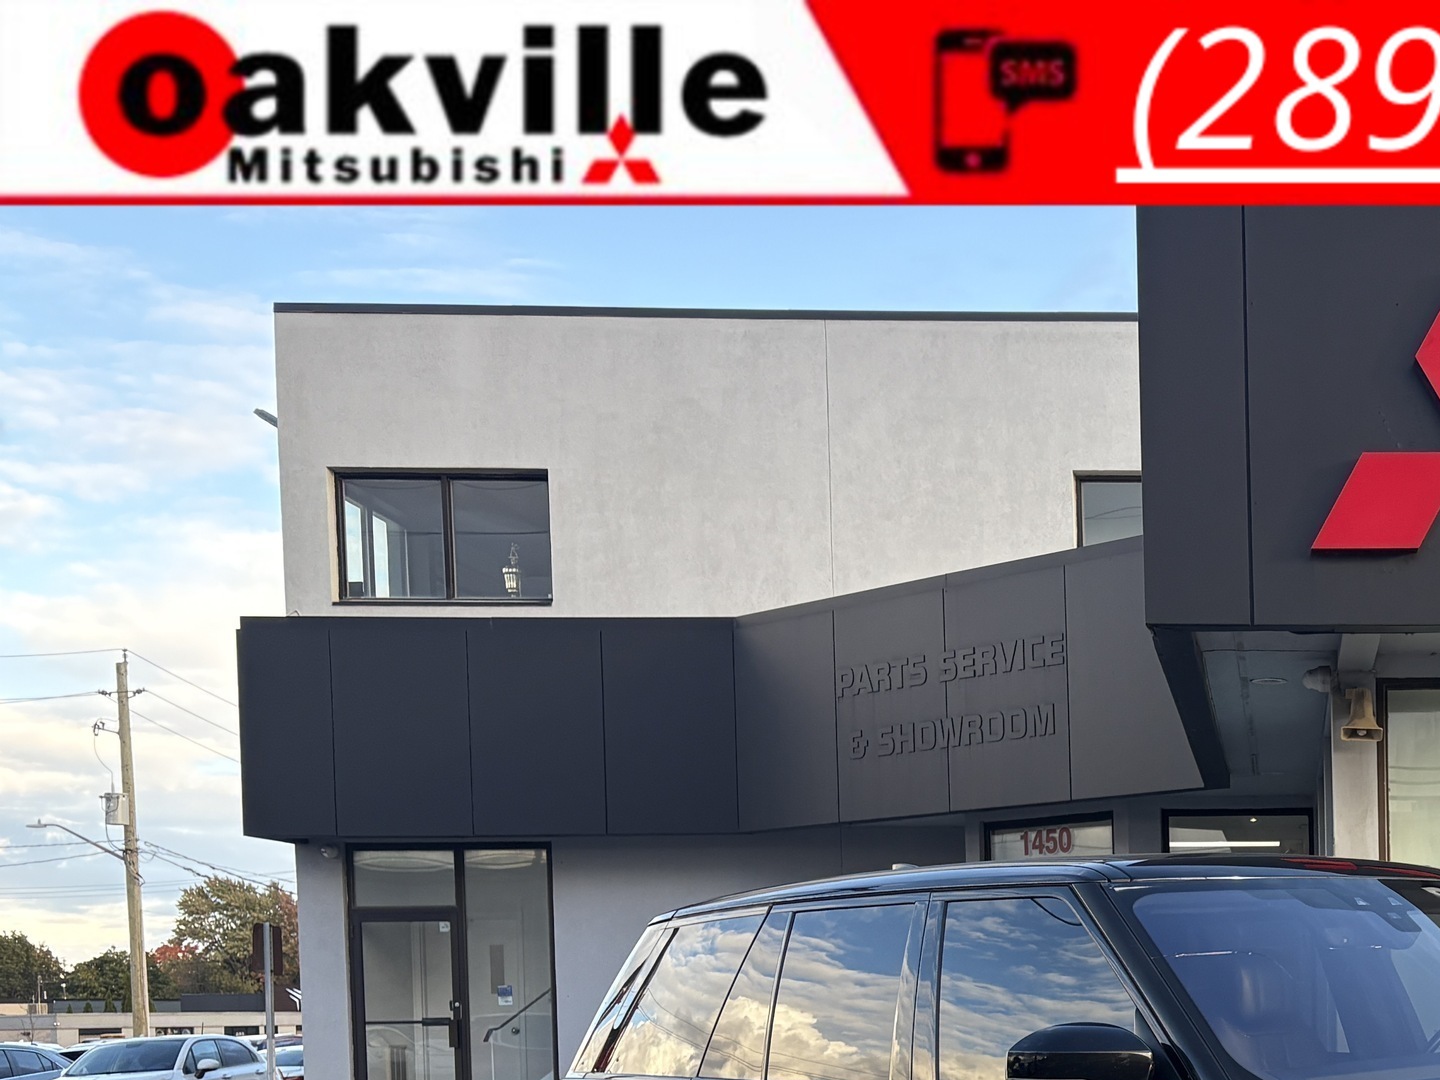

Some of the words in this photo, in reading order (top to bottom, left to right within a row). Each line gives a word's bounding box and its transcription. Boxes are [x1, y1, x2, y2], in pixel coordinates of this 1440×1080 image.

[836, 655, 928, 700] PARTS
[938, 632, 1066, 684] SERVICE
[850, 730, 870, 760] &
[877, 703, 1056, 758] SHOWROOM
[1020, 826, 1072, 856] 1450
